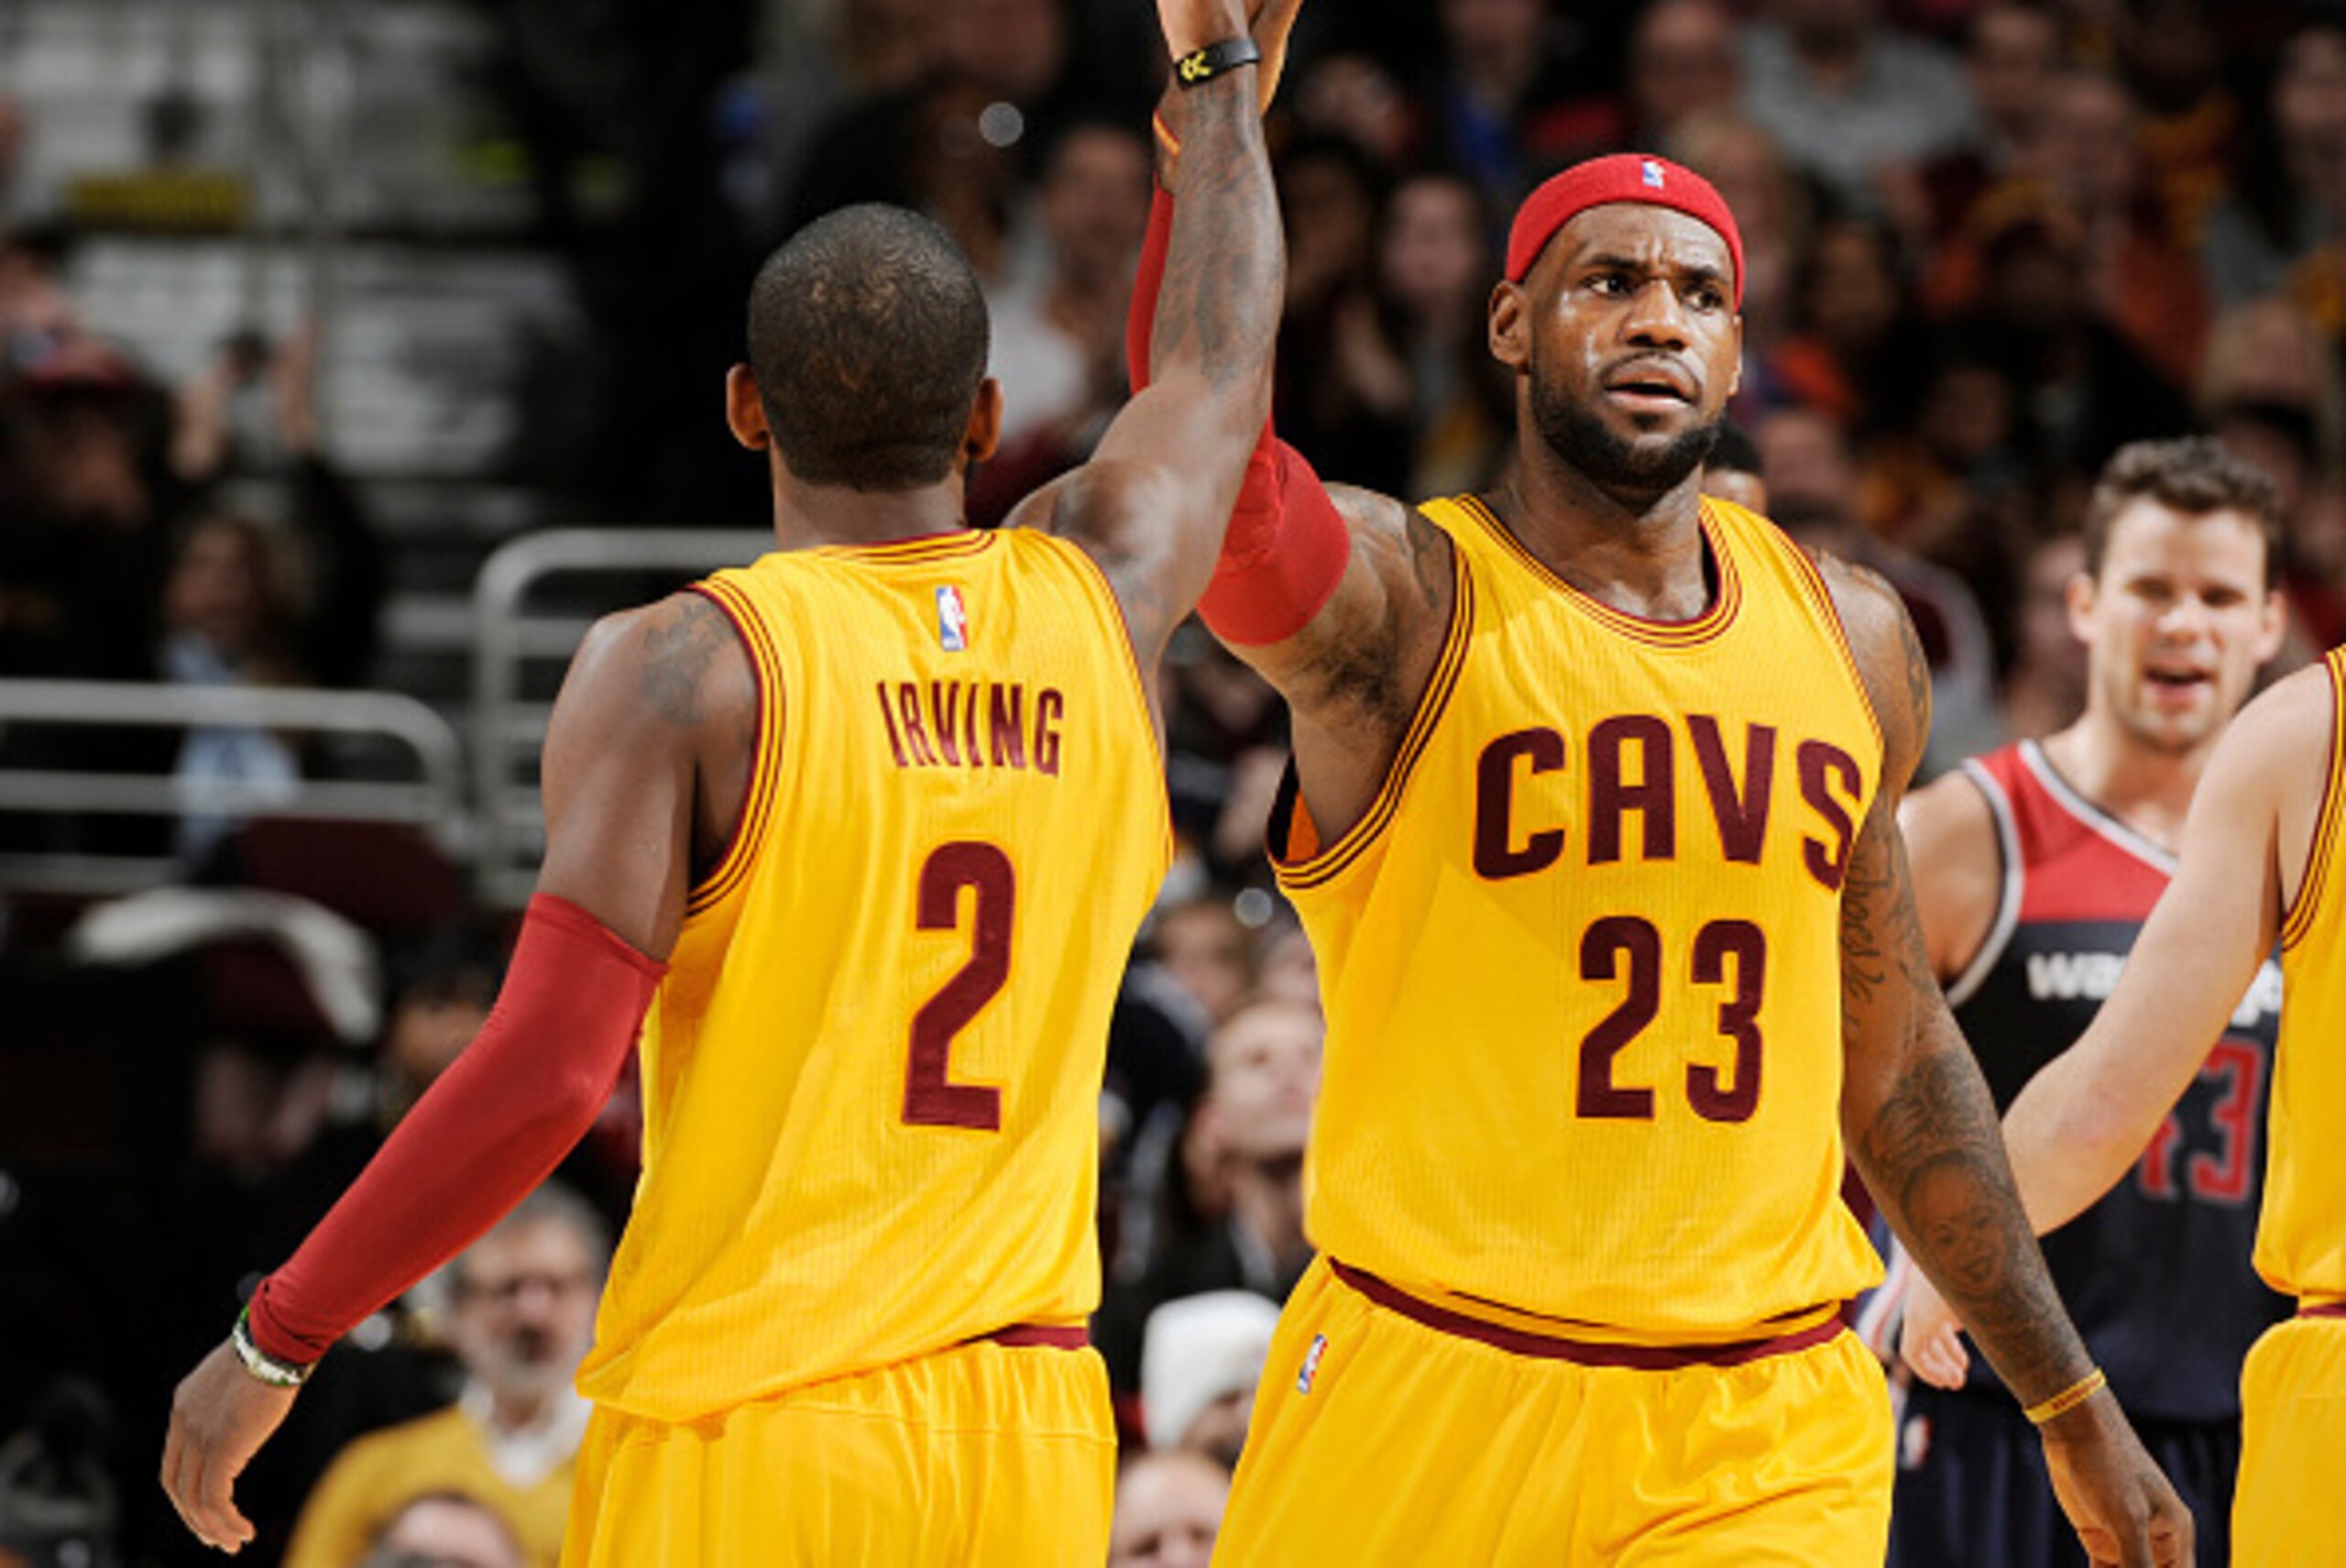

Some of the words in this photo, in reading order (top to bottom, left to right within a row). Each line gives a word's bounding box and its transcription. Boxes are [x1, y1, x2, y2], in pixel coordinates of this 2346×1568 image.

[877, 680, 1063, 777] IRVING
[1473, 714, 1861, 893] CAVS
[902, 840, 1015, 1131] 2
[1576, 916, 1767, 1123] 23
